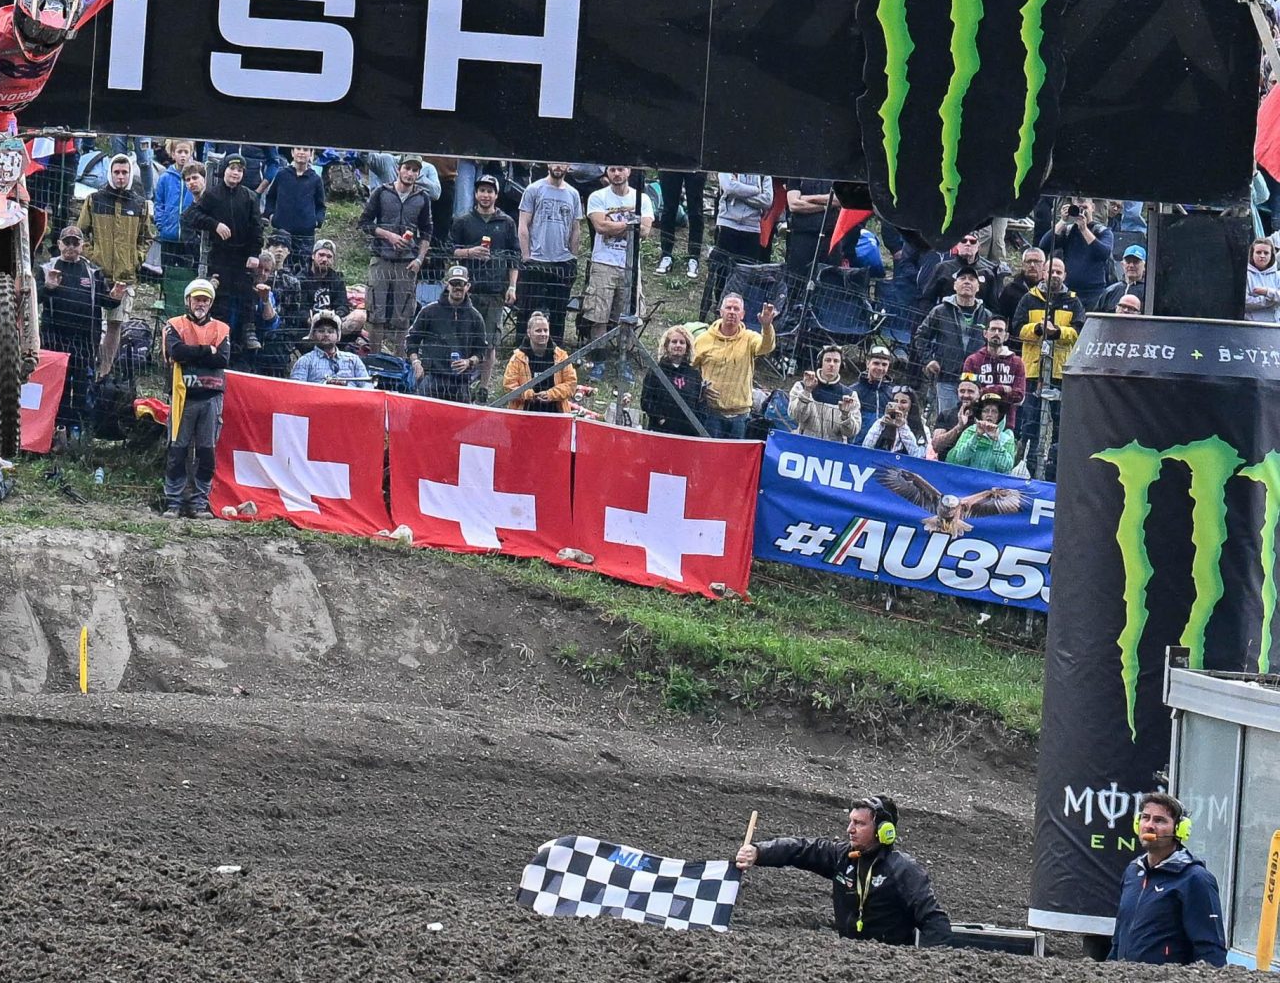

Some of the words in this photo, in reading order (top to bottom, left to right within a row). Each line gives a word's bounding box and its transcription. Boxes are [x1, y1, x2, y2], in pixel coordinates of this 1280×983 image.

[1085, 341, 1176, 360] GINSENG
[777, 451, 876, 493] ONLY
[774, 516, 1052, 603] #AU35
[1266, 850, 1280, 904] ACERBIS
